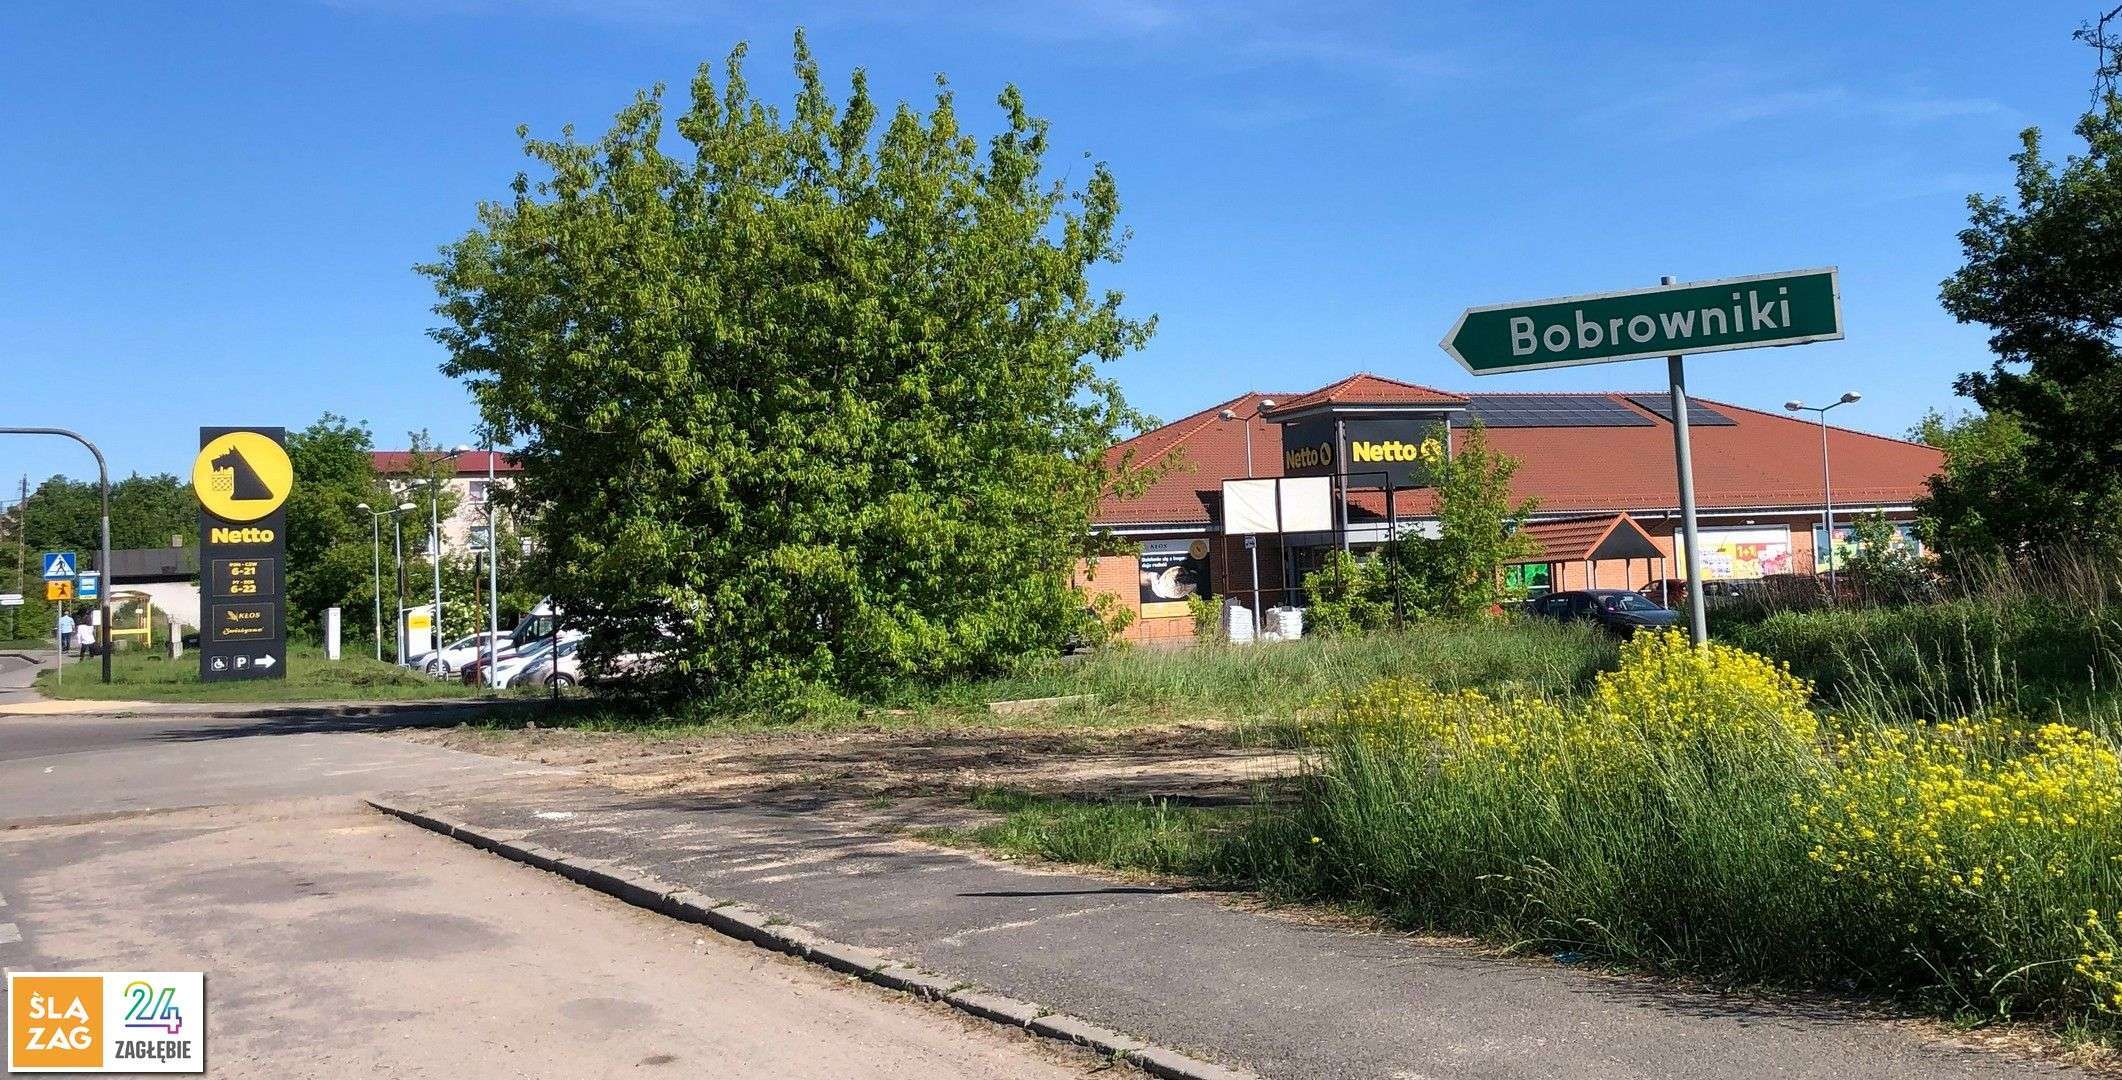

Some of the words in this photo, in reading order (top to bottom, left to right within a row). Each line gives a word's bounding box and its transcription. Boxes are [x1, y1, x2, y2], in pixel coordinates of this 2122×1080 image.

[1509, 286, 1791, 357] Bobrowniki
[1286, 447, 1318, 470] Netto
[1352, 441, 1417, 462] Netto
[211, 527, 275, 544] Netto
[231, 567, 256, 576] 6-21
[230, 585, 257, 593] 6-22
[237, 657, 247, 668] P
